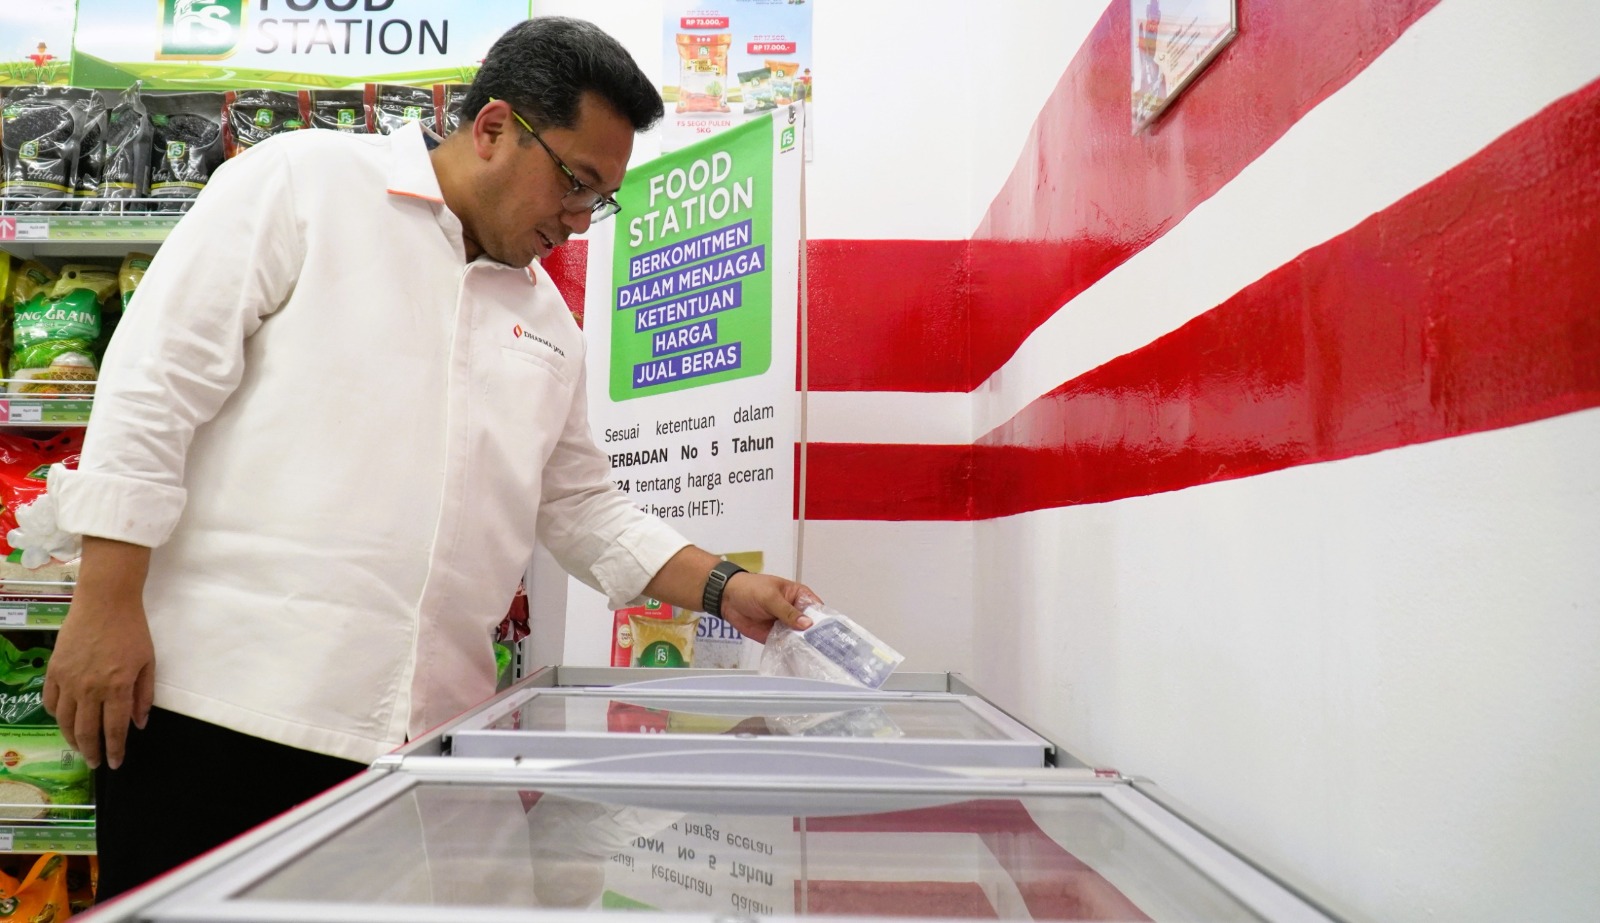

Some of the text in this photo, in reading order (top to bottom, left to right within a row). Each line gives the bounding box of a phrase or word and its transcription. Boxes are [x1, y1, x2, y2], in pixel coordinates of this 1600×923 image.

[255, 18, 449, 55] STATION
[649, 150, 732, 207] FOOD
[629, 177, 753, 248] STATION
[632, 225, 749, 278] BERKOMITMEN
[620, 251, 761, 307] DALAM MENJAGA
[15, 309, 96, 326] ONG GRAIN
[638, 288, 734, 329] KETENTUAN
[655, 324, 713, 353] HARGA
[636, 346, 737, 384] JUAL BERAS
[605, 405, 774, 443] Sesuai ketentuan dalam
[608, 436, 774, 468] ERBADAN No 5 Tahun
[613, 467, 774, 494] 24 tentang harga eceran
[687, 499, 724, 518] (HET):
